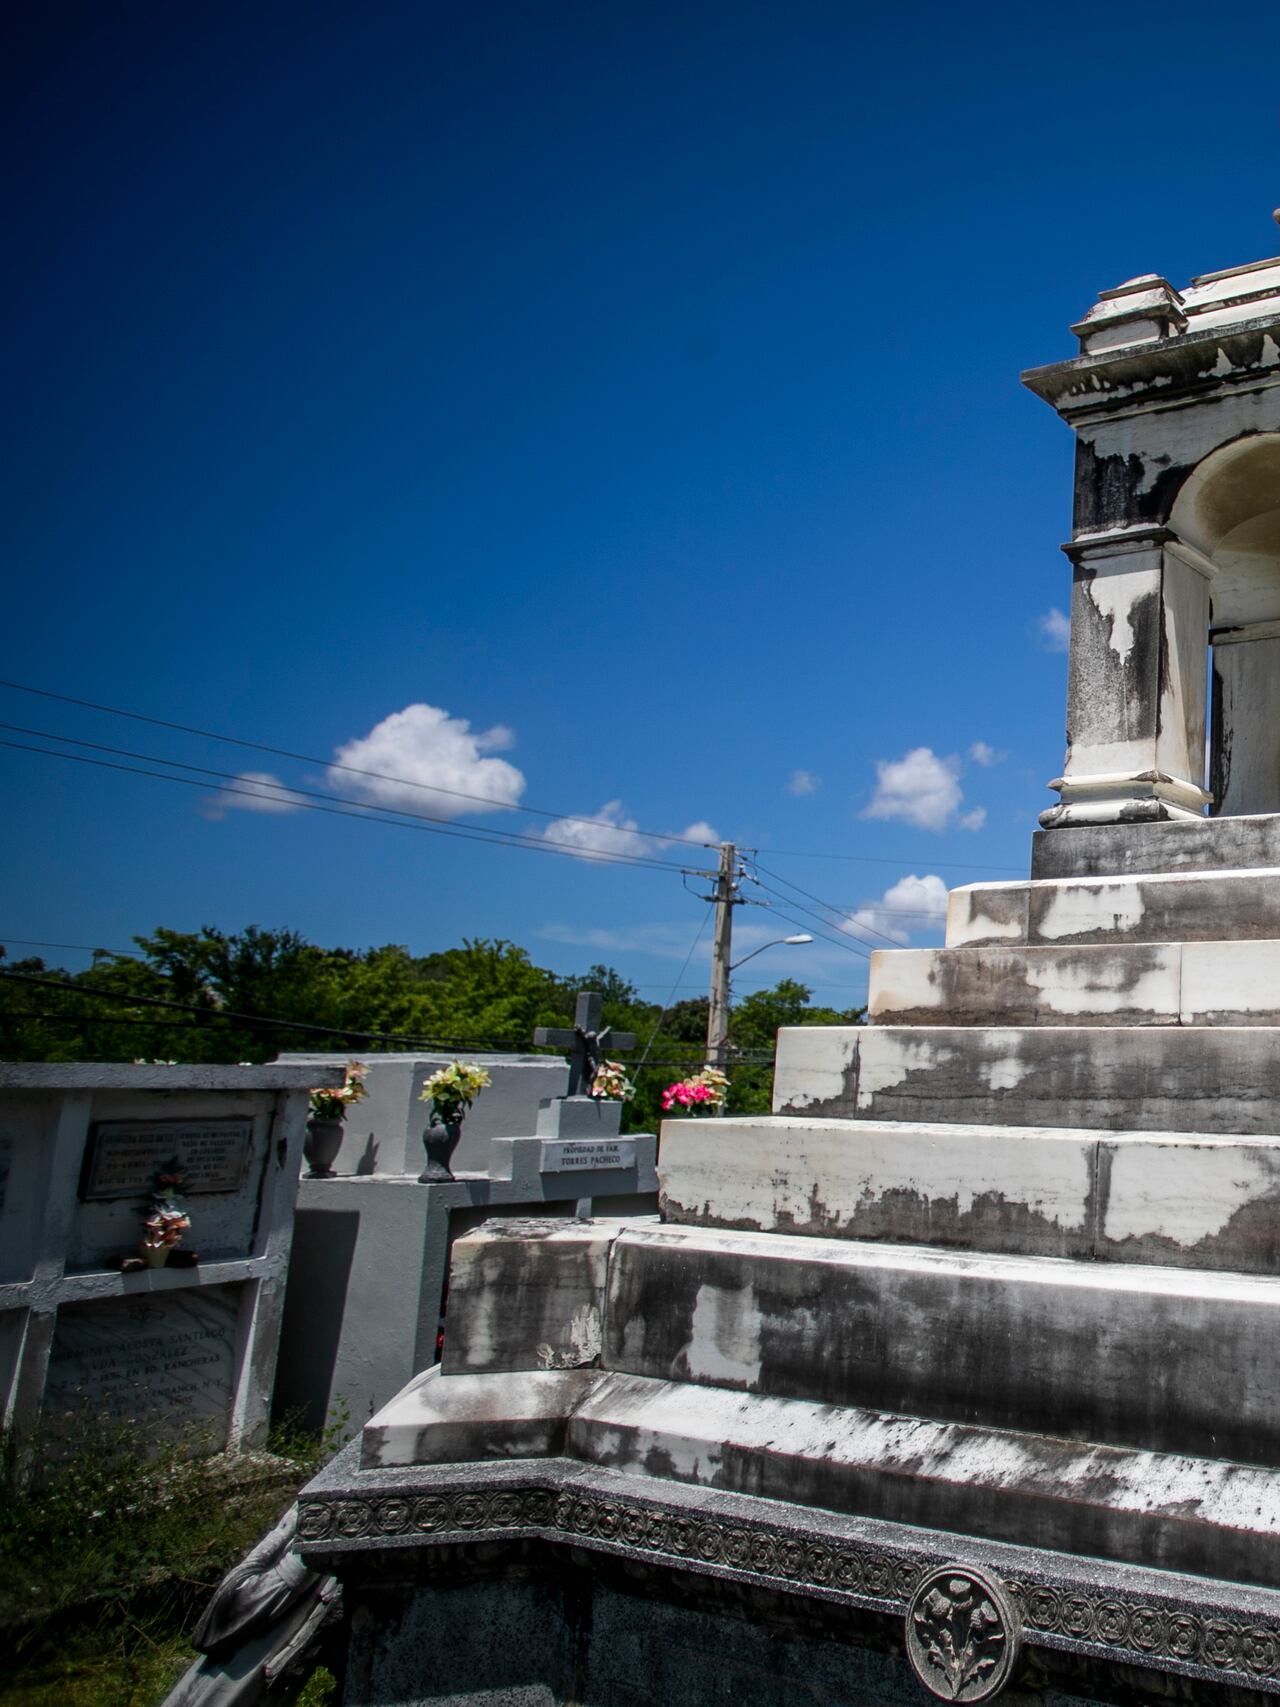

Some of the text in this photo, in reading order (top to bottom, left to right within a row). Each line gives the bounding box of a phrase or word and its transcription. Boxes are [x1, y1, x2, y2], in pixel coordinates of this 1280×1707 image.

[597, 1145, 604, 1153] DE
[561, 1155, 620, 1166] TORRES PACHECO
[168, 1327, 226, 1346] SANTIAGO
